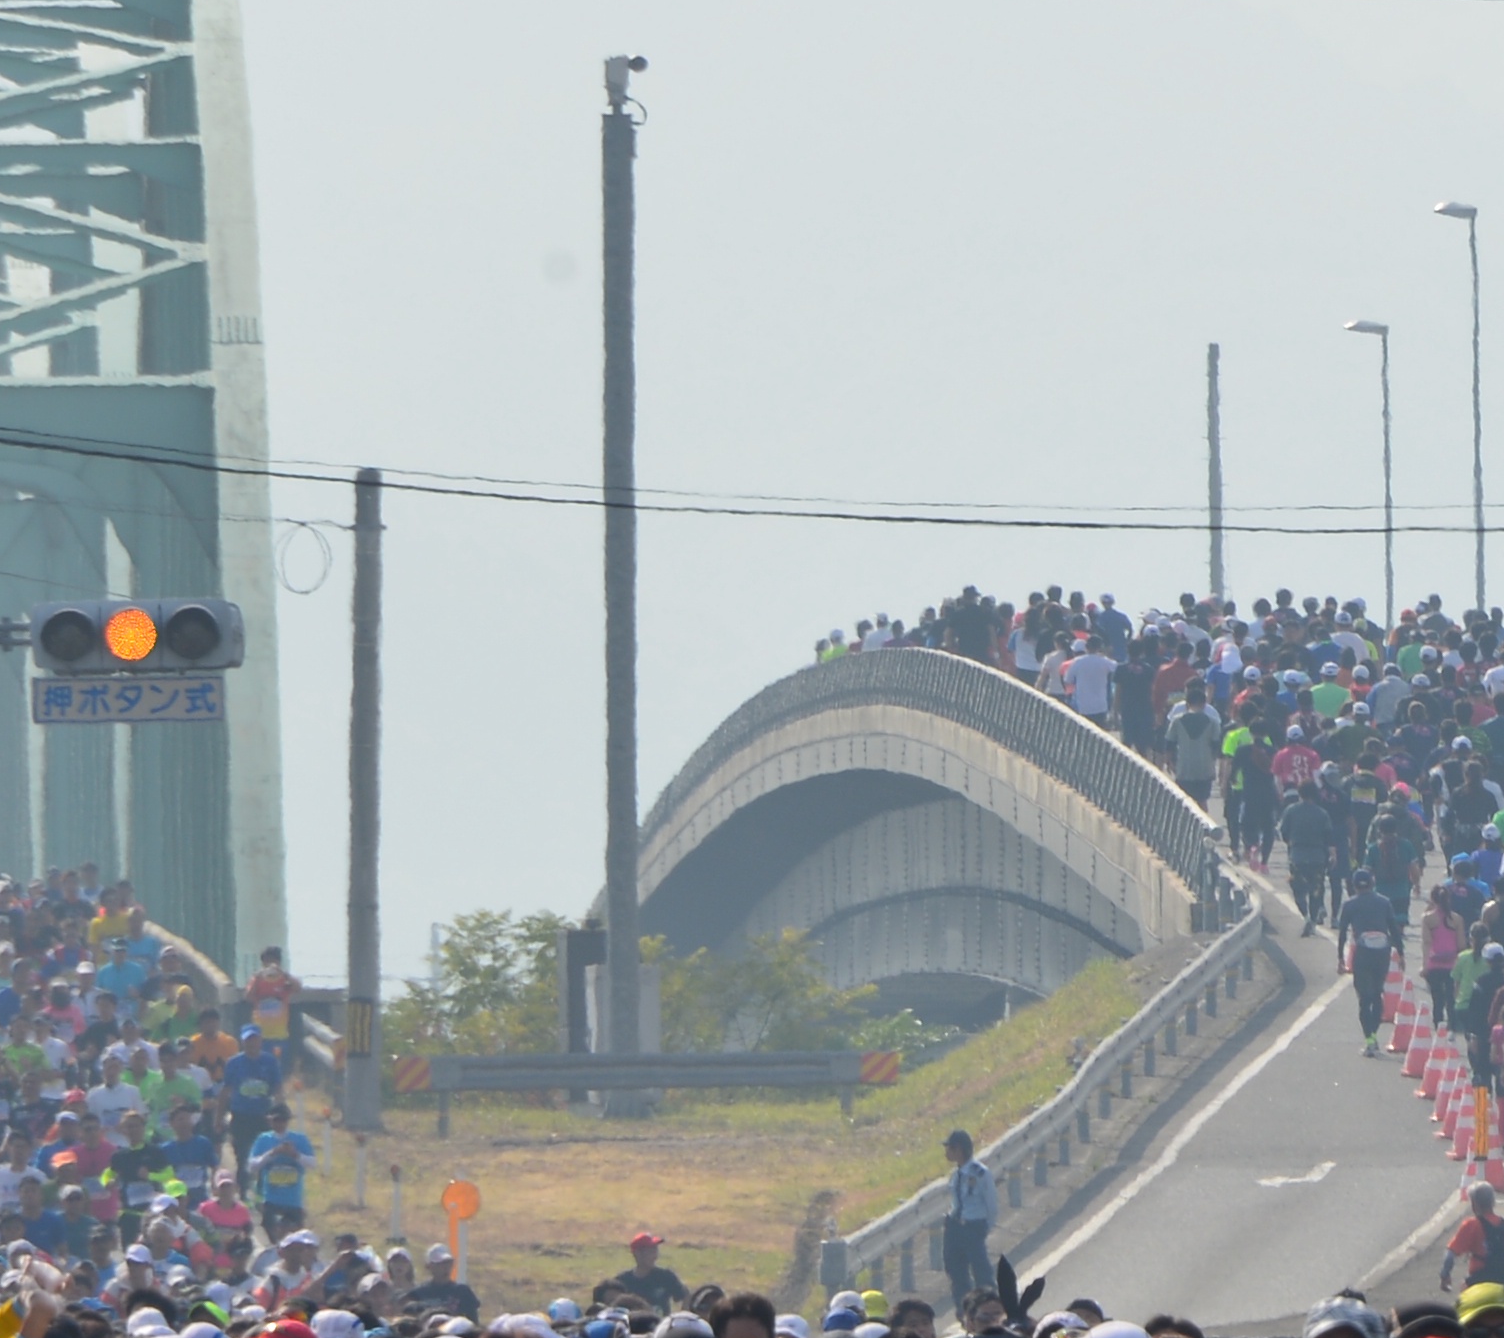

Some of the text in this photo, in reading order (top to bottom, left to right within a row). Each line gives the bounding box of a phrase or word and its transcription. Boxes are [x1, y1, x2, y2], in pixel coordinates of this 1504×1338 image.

[44, 682, 217, 717] 押ボタン式
